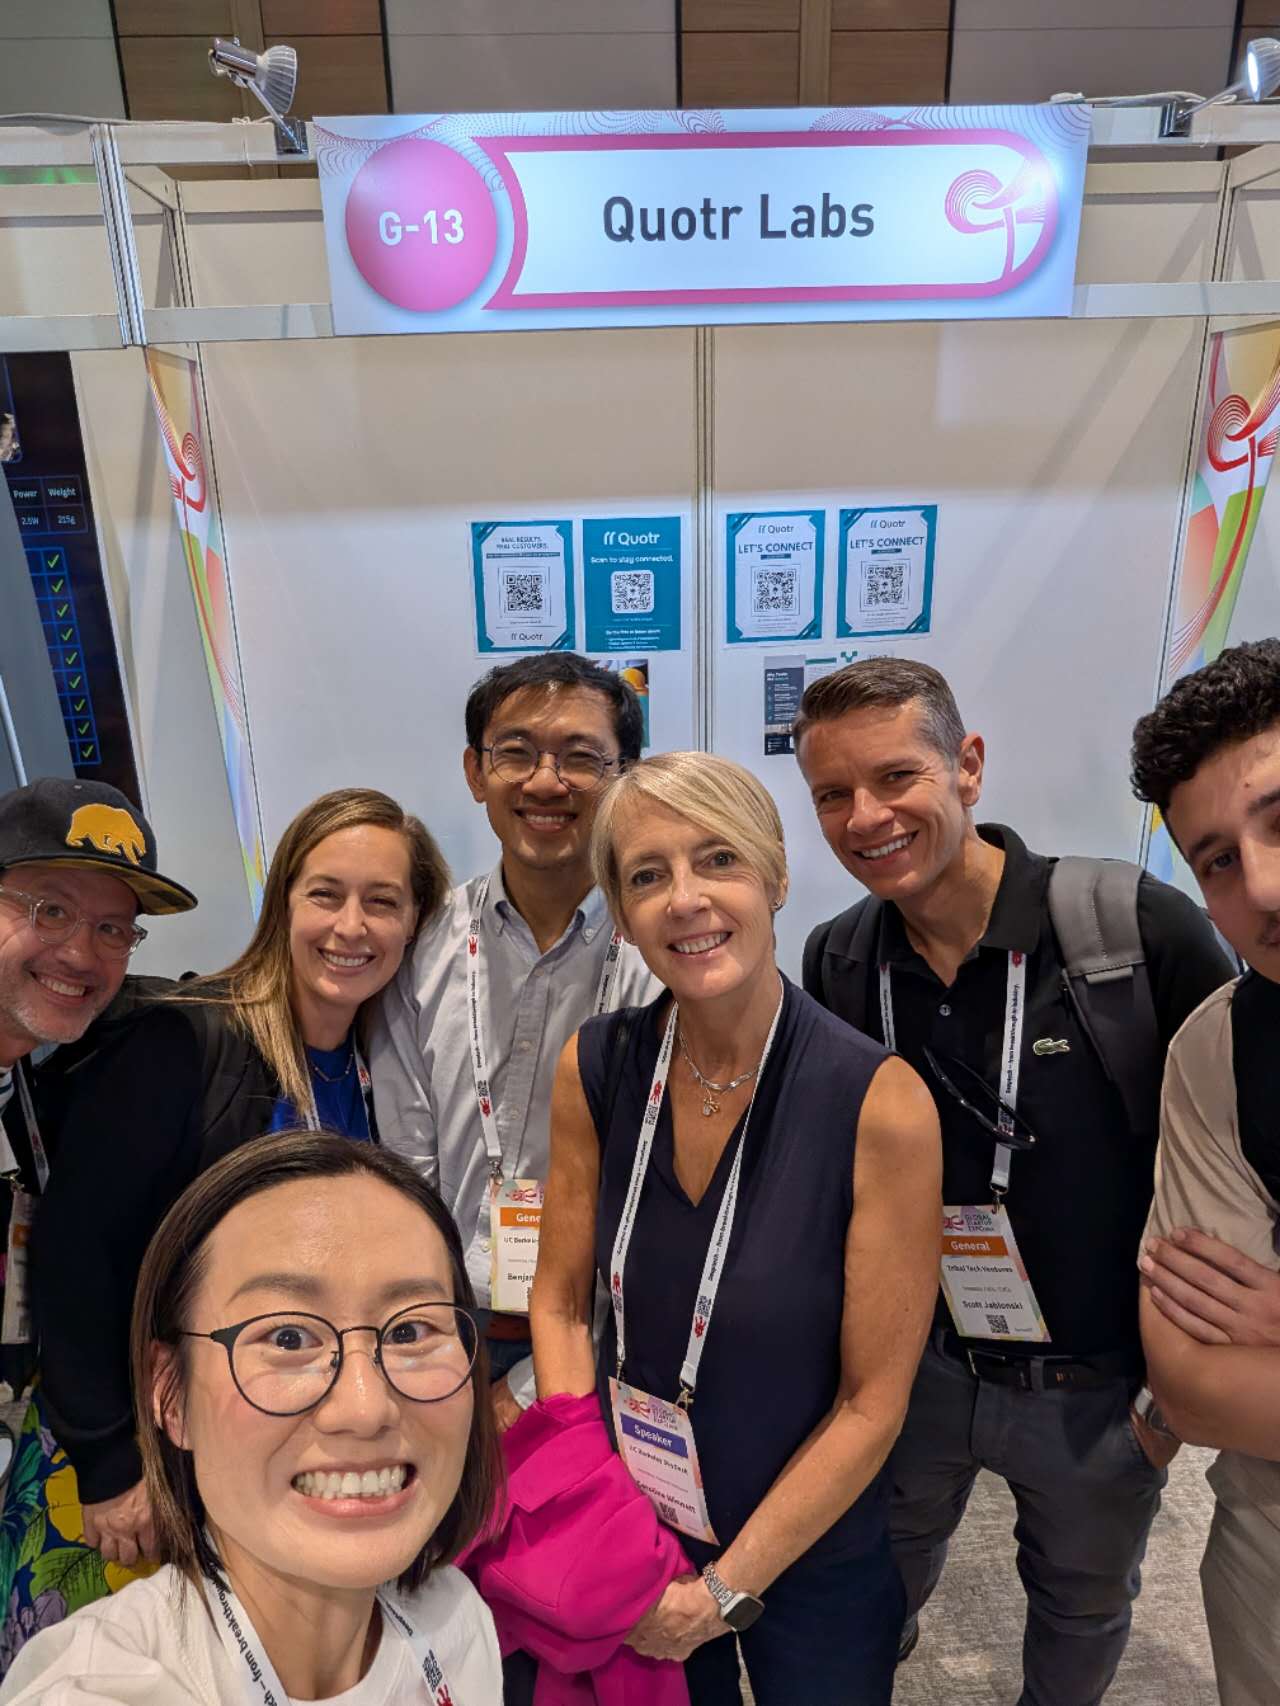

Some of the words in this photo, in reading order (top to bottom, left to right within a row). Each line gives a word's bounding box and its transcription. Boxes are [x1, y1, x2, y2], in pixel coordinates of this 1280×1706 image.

[603, 196, 743, 243] Quotr
[760, 192, 875, 238] Labs
[379, 210, 464, 246] G-13
[13, 490, 38, 498] Power
[48, 487, 76, 498] Weight
[767, 524, 794, 534] Quotr
[879, 519, 906, 529] Quotr
[618, 531, 660, 546] Quotr
[850, 539, 874, 549] LET'S
[876, 536, 924, 547] CONNECT
[738, 543, 763, 554] LET'S
[765, 541, 813, 552] CONNECT
[518, 632, 544, 642] Quotr
[516, 1211, 541, 1223] Gene
[950, 1240, 991, 1251] General
[634, 1424, 673, 1447] Speaker
[243, 1649, 263, 1682] from
